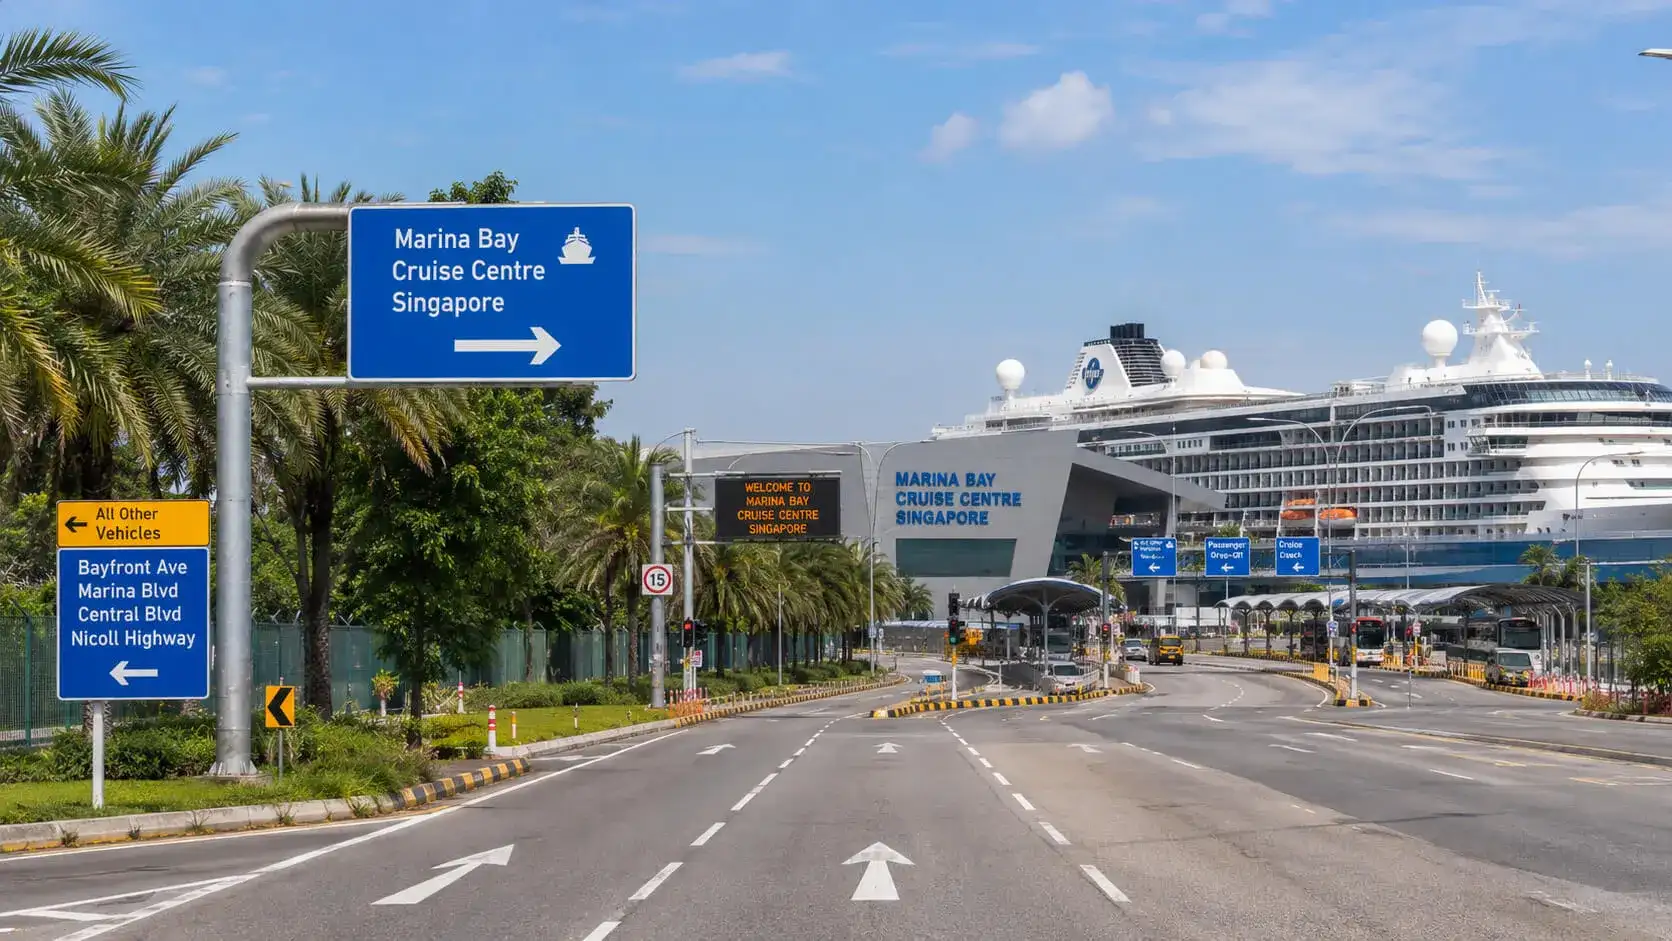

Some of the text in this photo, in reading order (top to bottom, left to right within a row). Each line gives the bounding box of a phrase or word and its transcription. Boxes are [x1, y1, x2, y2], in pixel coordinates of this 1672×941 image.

[395, 228, 520, 254] Marina Bay
[392, 260, 546, 281] Cruise Centre
[392, 292, 505, 318] Singapore
[895, 471, 997, 487] MARINA BAY
[745, 482, 812, 493] WELCOME TO
[746, 496, 810, 507] MARINA BAY
[895, 491, 1022, 507] CRUISE CENTRE
[96, 507, 159, 520] All Other
[737, 510, 820, 521] CRUISE CENTRE
[895, 510, 989, 526] SINGAPORE
[96, 525, 161, 541] Vehicles
[749, 524, 807, 534] SINGAPORE
[78, 559, 188, 579] Bayfront Ave
[650, 573, 665, 587] 15
[78, 582, 179, 599] Marina Blvd
[78, 606, 182, 622] Central Blvd
[71, 630, 196, 650] Nicoll Highway
